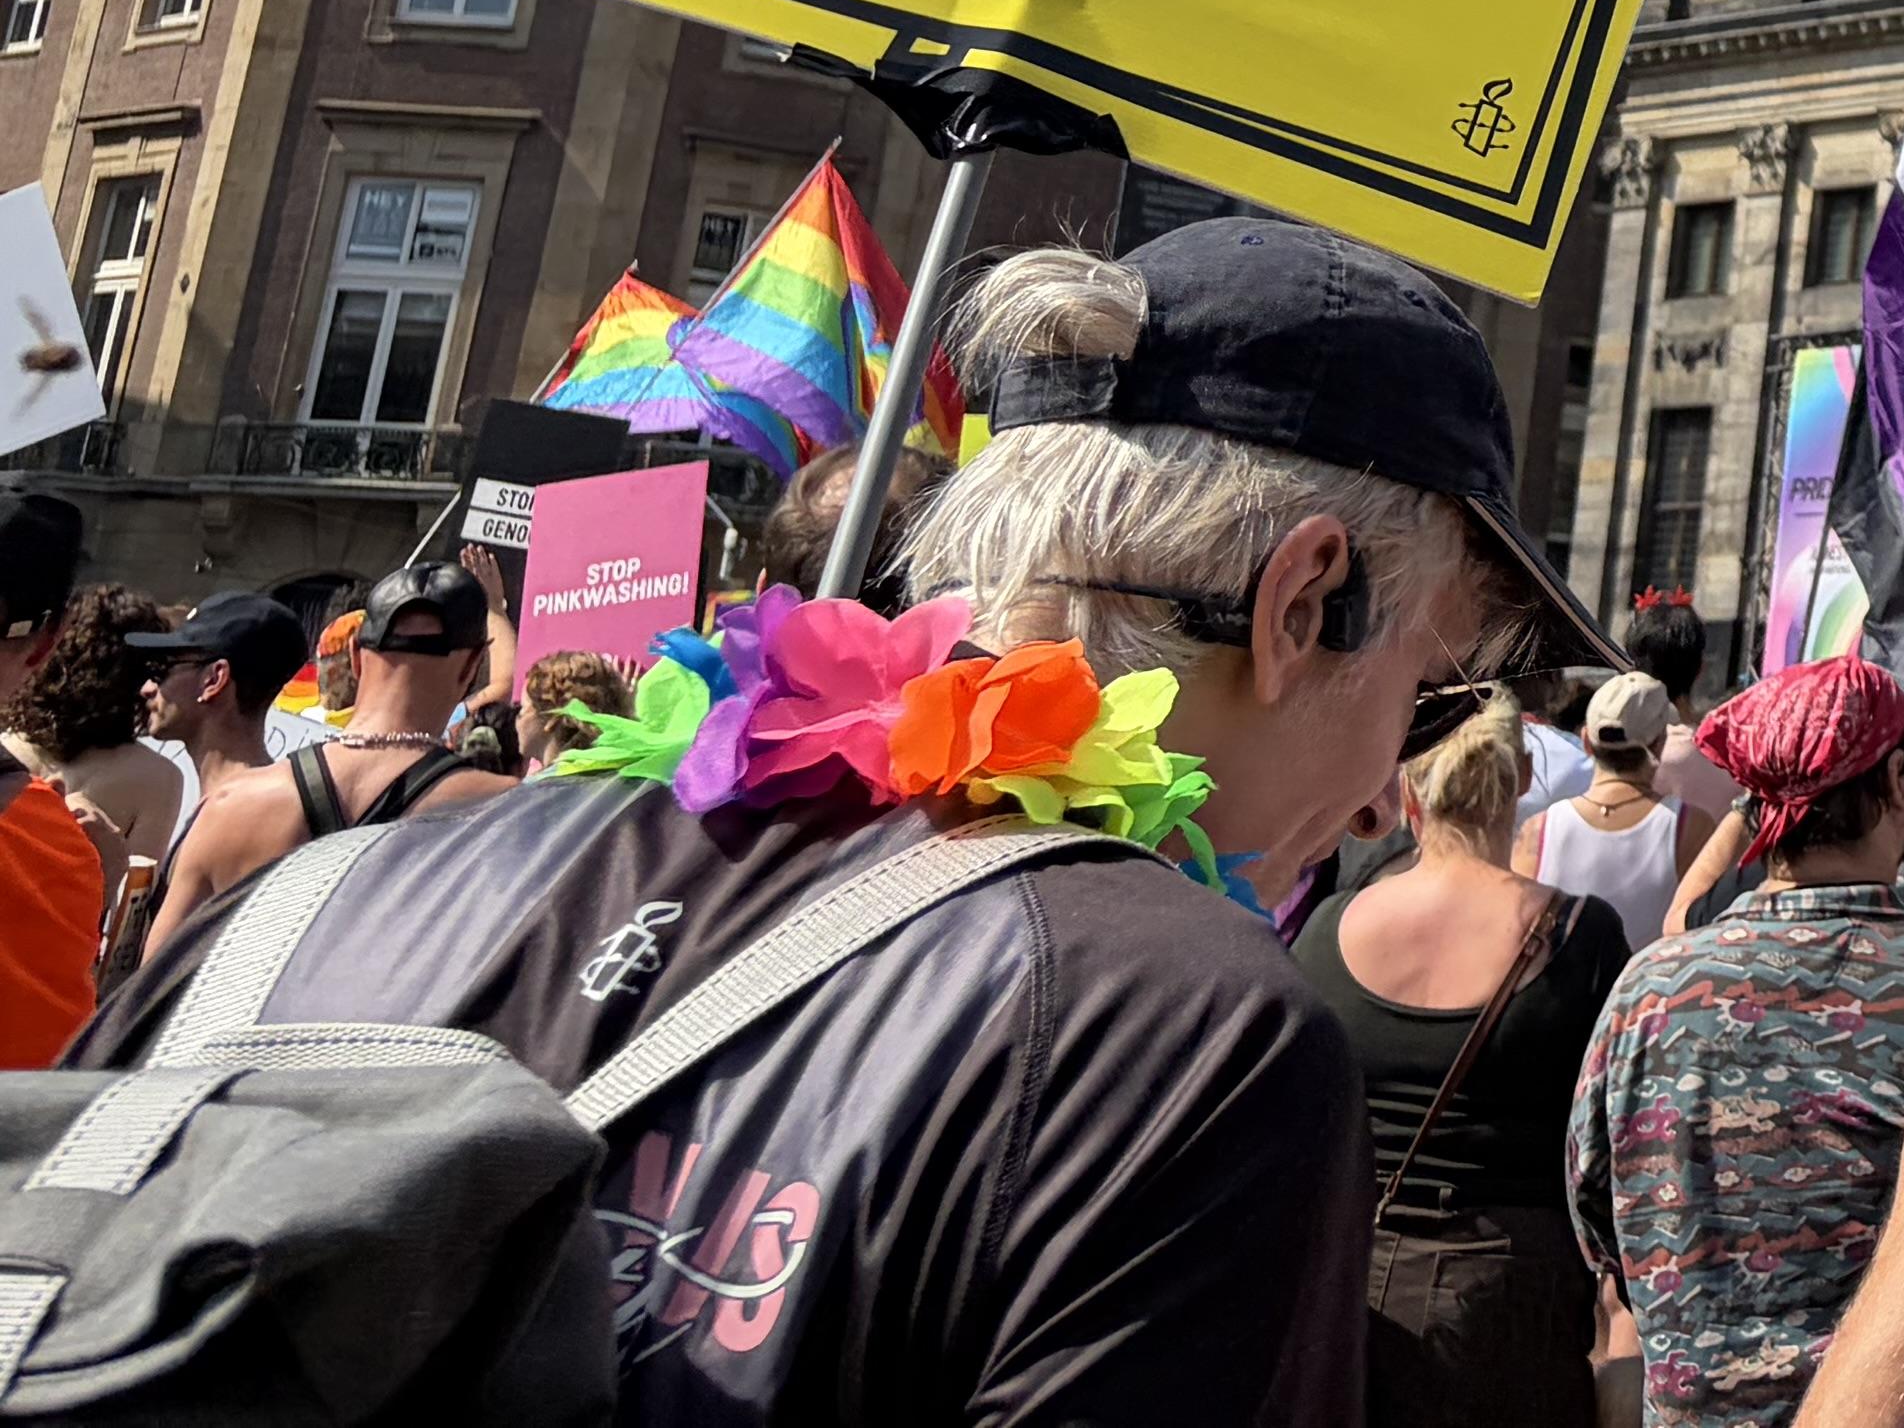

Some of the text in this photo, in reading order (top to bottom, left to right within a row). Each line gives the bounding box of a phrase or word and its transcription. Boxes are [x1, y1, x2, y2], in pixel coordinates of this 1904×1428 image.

[482, 518, 532, 544] GENO
[586, 556, 641, 586] STOP
[532, 571, 690, 618] PINKWASHING!
